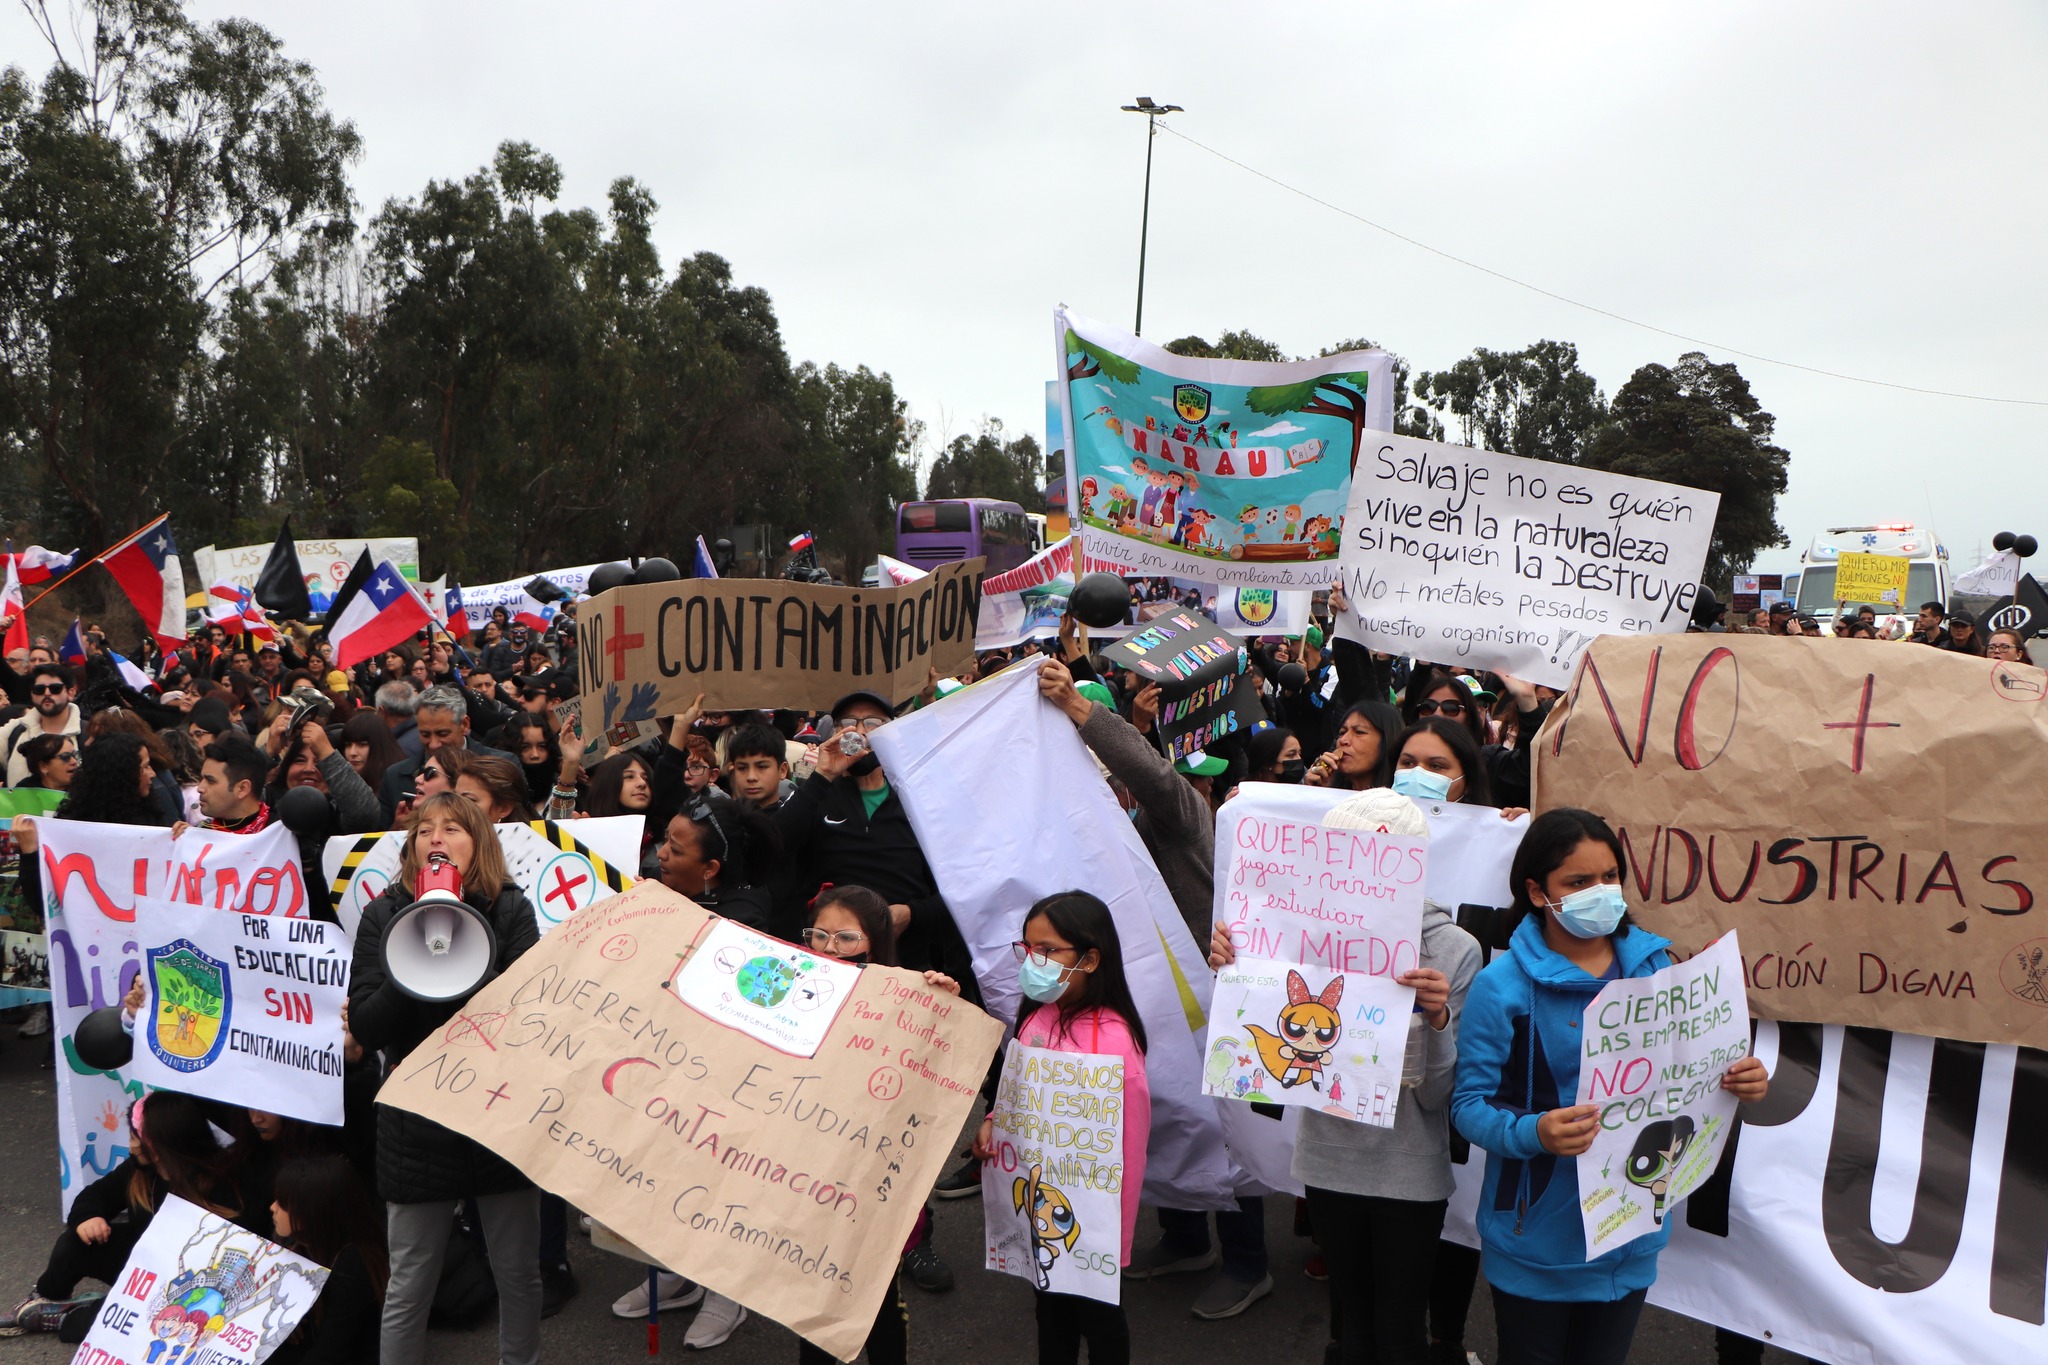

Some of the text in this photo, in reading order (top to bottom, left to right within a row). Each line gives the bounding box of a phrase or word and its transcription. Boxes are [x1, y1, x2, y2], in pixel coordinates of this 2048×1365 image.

[1133, 428, 1267, 477] NARAU
[1376, 445, 1692, 531] Salvaje no es quién
[1366, 497, 1669, 566] vive en la naturaleza
[230, 550, 260, 568] LAS
[1138, 552, 1167, 569] en
[1172, 560, 1205, 576] un
[1216, 566, 1295, 586] ambiente
[1515, 545, 1542, 580] la
[1842, 555, 1907, 574] QUIERO MIS
[1892, 575, 1905, 585] NO
[498, 593, 525, 606] Sur
[1418, 576, 1505, 609] metales
[1620, 616, 1653, 633] en
[1357, 613, 1426, 640] nuestro
[580, 612, 604, 696] NO
[1163, 673, 1236, 726] NUESTROS
[1552, 645, 1740, 770] NO
[1168, 709, 1239, 766] DERECHOS
[1236, 815, 1424, 885] QUEREMOS
[1618, 824, 2035, 916] NDUSTRIAS
[1230, 889, 1369, 930] y estudiar
[242, 915, 325, 944] POR UNA
[234, 944, 348, 988] EDUCACIÓN
[1220, 973, 1279, 987] QUIERO ESTO
[264, 987, 313, 1025] SIN
[853, 1000, 884, 1021] Para
[880, 976, 952, 1019] Dignidad
[1356, 1004, 1386, 1026] NO
[504, 1011, 588, 1062] SIN
[510, 963, 711, 1082] QUEREMOS
[1349, 1028, 1375, 1040] ESTO
[1585, 999, 1733, 1058] LAS EMPRESAS
[230, 1028, 343, 1077] CONTAMINACIÓN
[846, 1034, 875, 1051] NO
[1588, 1037, 1748, 1101] NO NUESTROS
[1051, 1091, 1122, 1127] ESTAR
[1017, 1146, 1044, 1163] LOS
[1073, 1249, 1117, 1276] SOS
[122, 1267, 158, 1301] NO
[102, 1302, 139, 1336] QUE
[218, 1322, 258, 1353] DEJES
